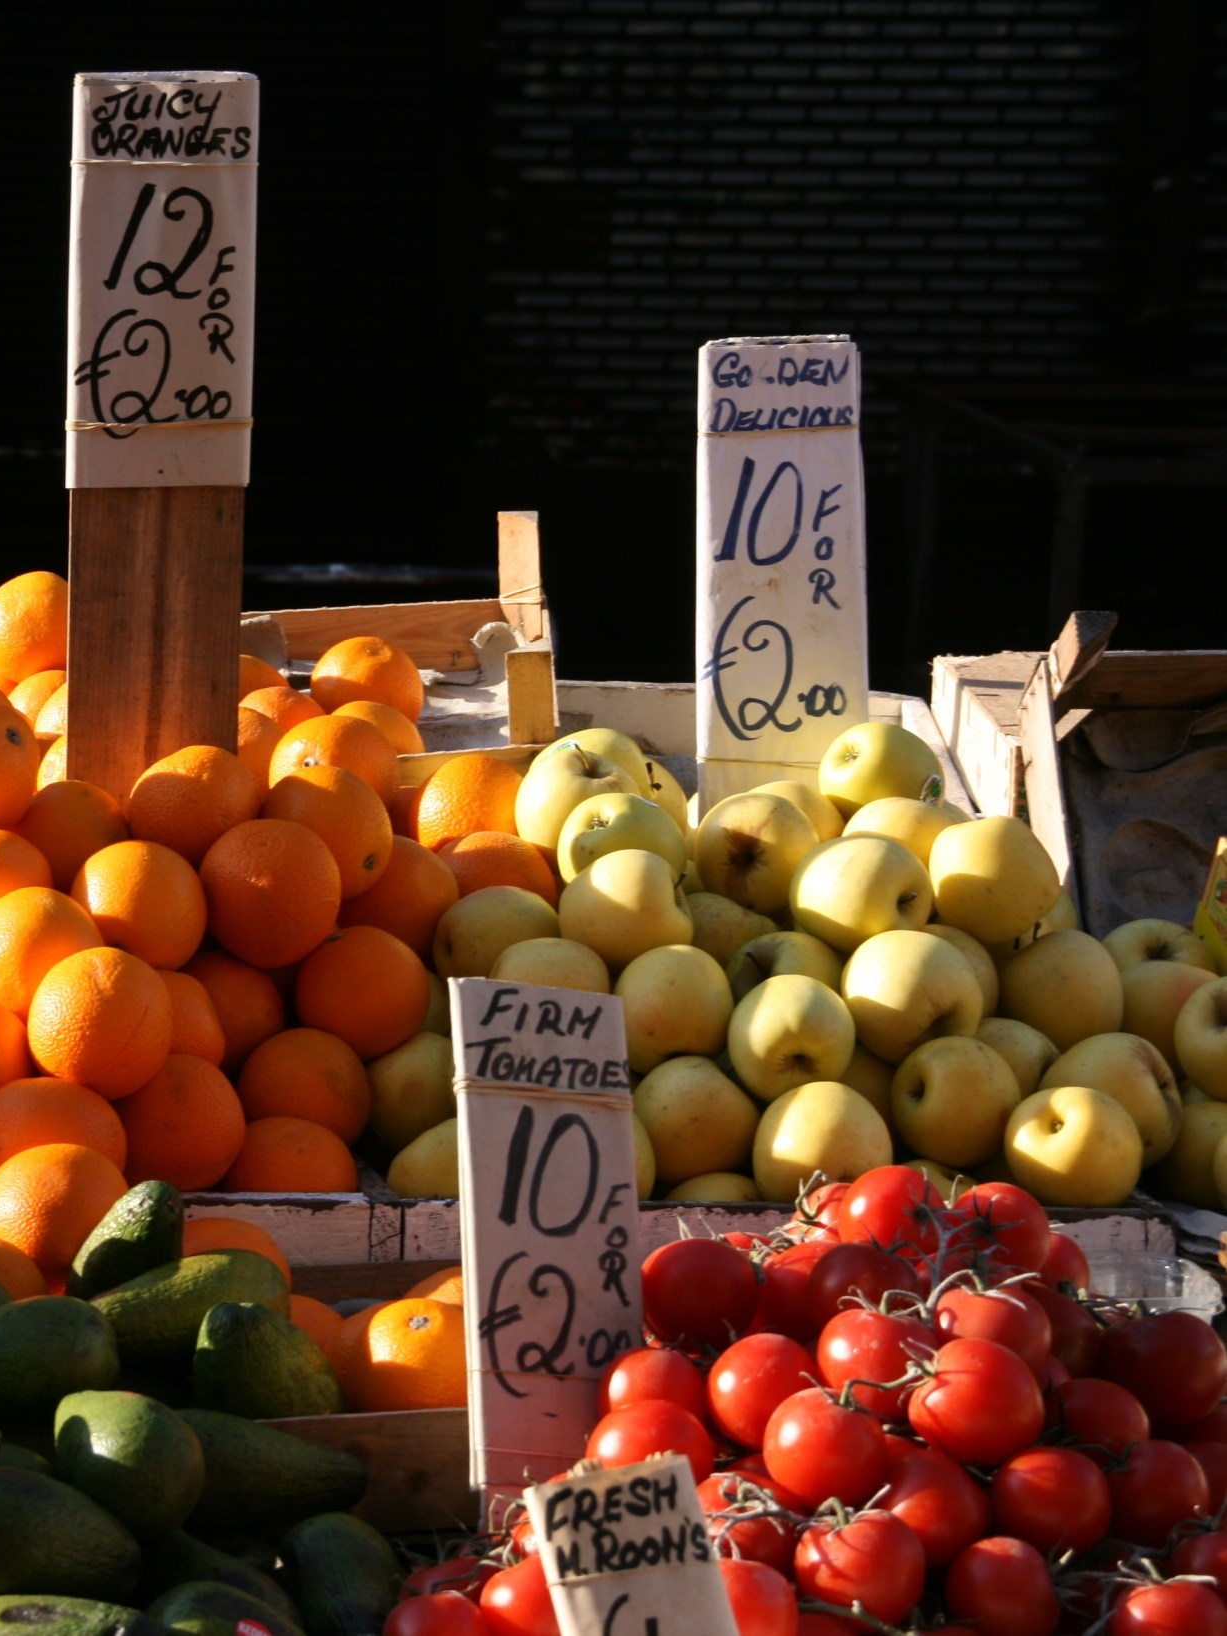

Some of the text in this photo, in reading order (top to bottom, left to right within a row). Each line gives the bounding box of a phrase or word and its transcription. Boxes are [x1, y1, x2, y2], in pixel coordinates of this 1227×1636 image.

[92, 87, 222, 137] JUICY
[91, 122, 252, 160] ORANGES
[103, 183, 236, 364] 12 FOR
[712, 351, 850, 388] GODEN
[710, 397, 854, 432] DELICIOUS
[714, 456, 842, 610] 10 FOR
[480, 988, 603, 1040] FIRM
[498, 1105, 631, 1307] 10 FOR
[546, 1472, 678, 1542] FRESH
